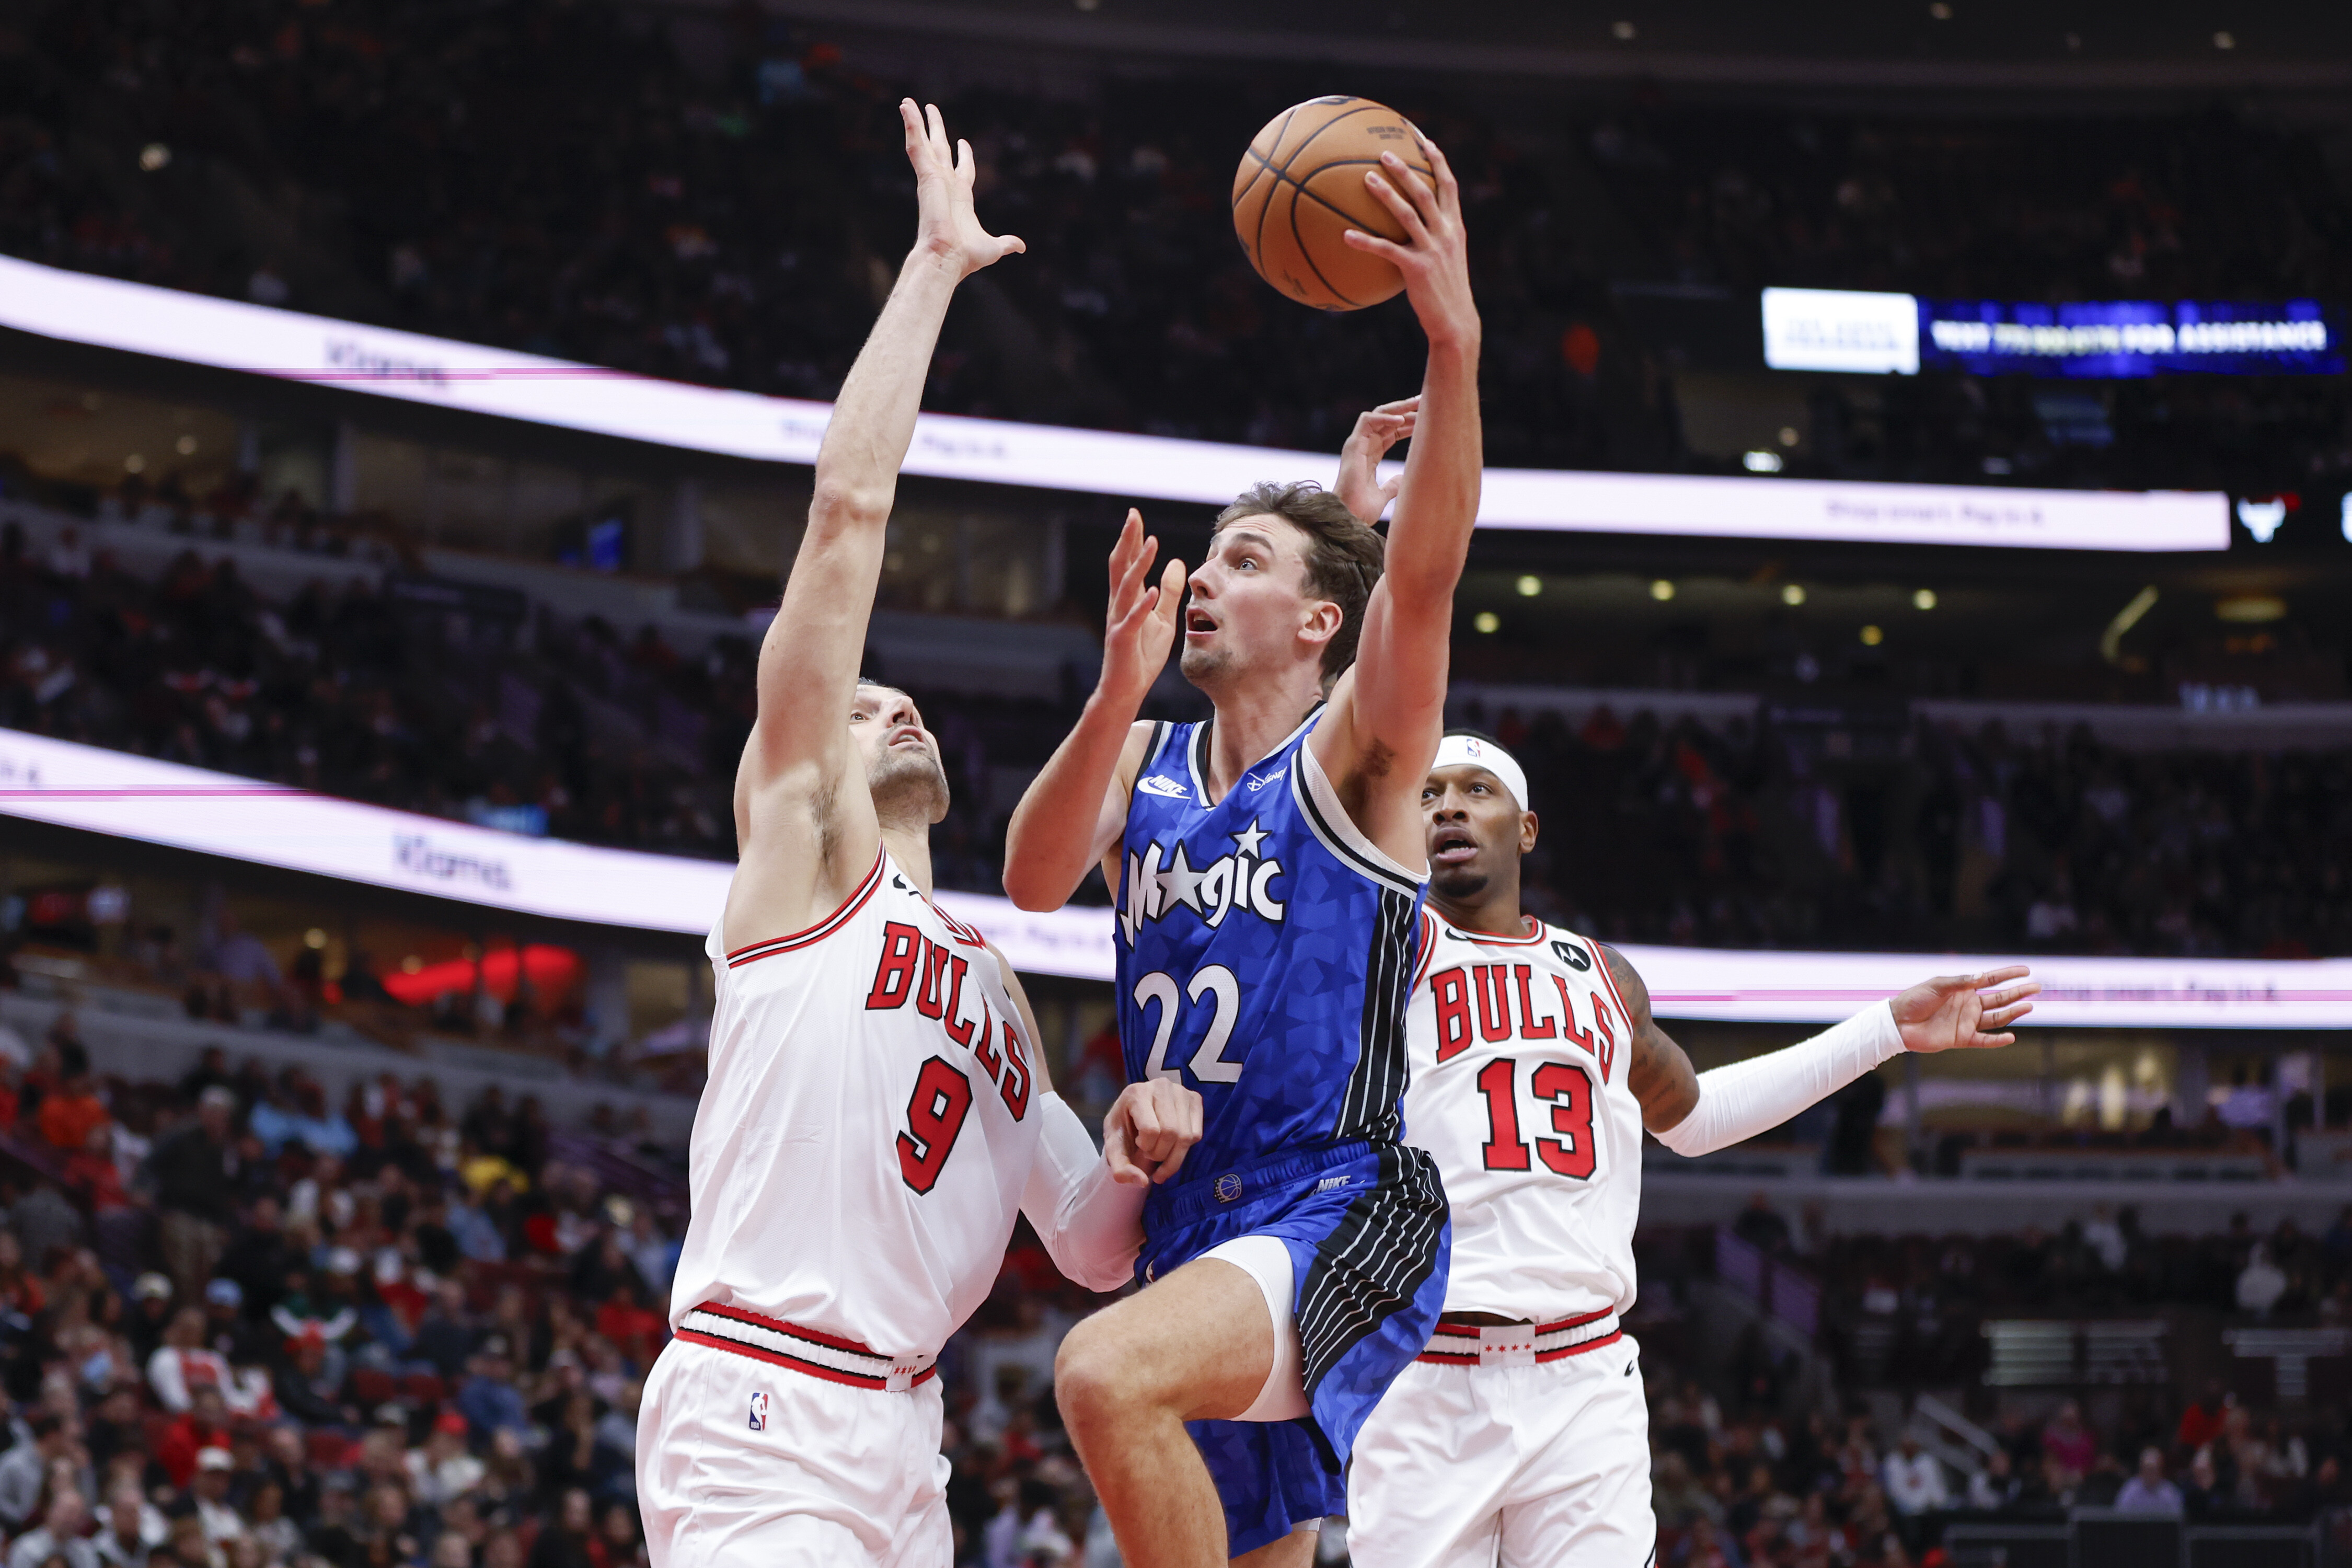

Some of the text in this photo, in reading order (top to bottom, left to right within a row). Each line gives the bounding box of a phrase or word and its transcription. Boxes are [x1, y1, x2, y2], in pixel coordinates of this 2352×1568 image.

[1149, 774, 1187, 794] NIKE
[864, 920, 1030, 1123] BULLS
[1133, 963, 1243, 1086] 22
[1430, 964, 1615, 1087] BULLS
[895, 1054, 973, 1197] 9
[1477, 1057, 1597, 1181] 13
[1316, 1175, 1351, 1193] NIKE
